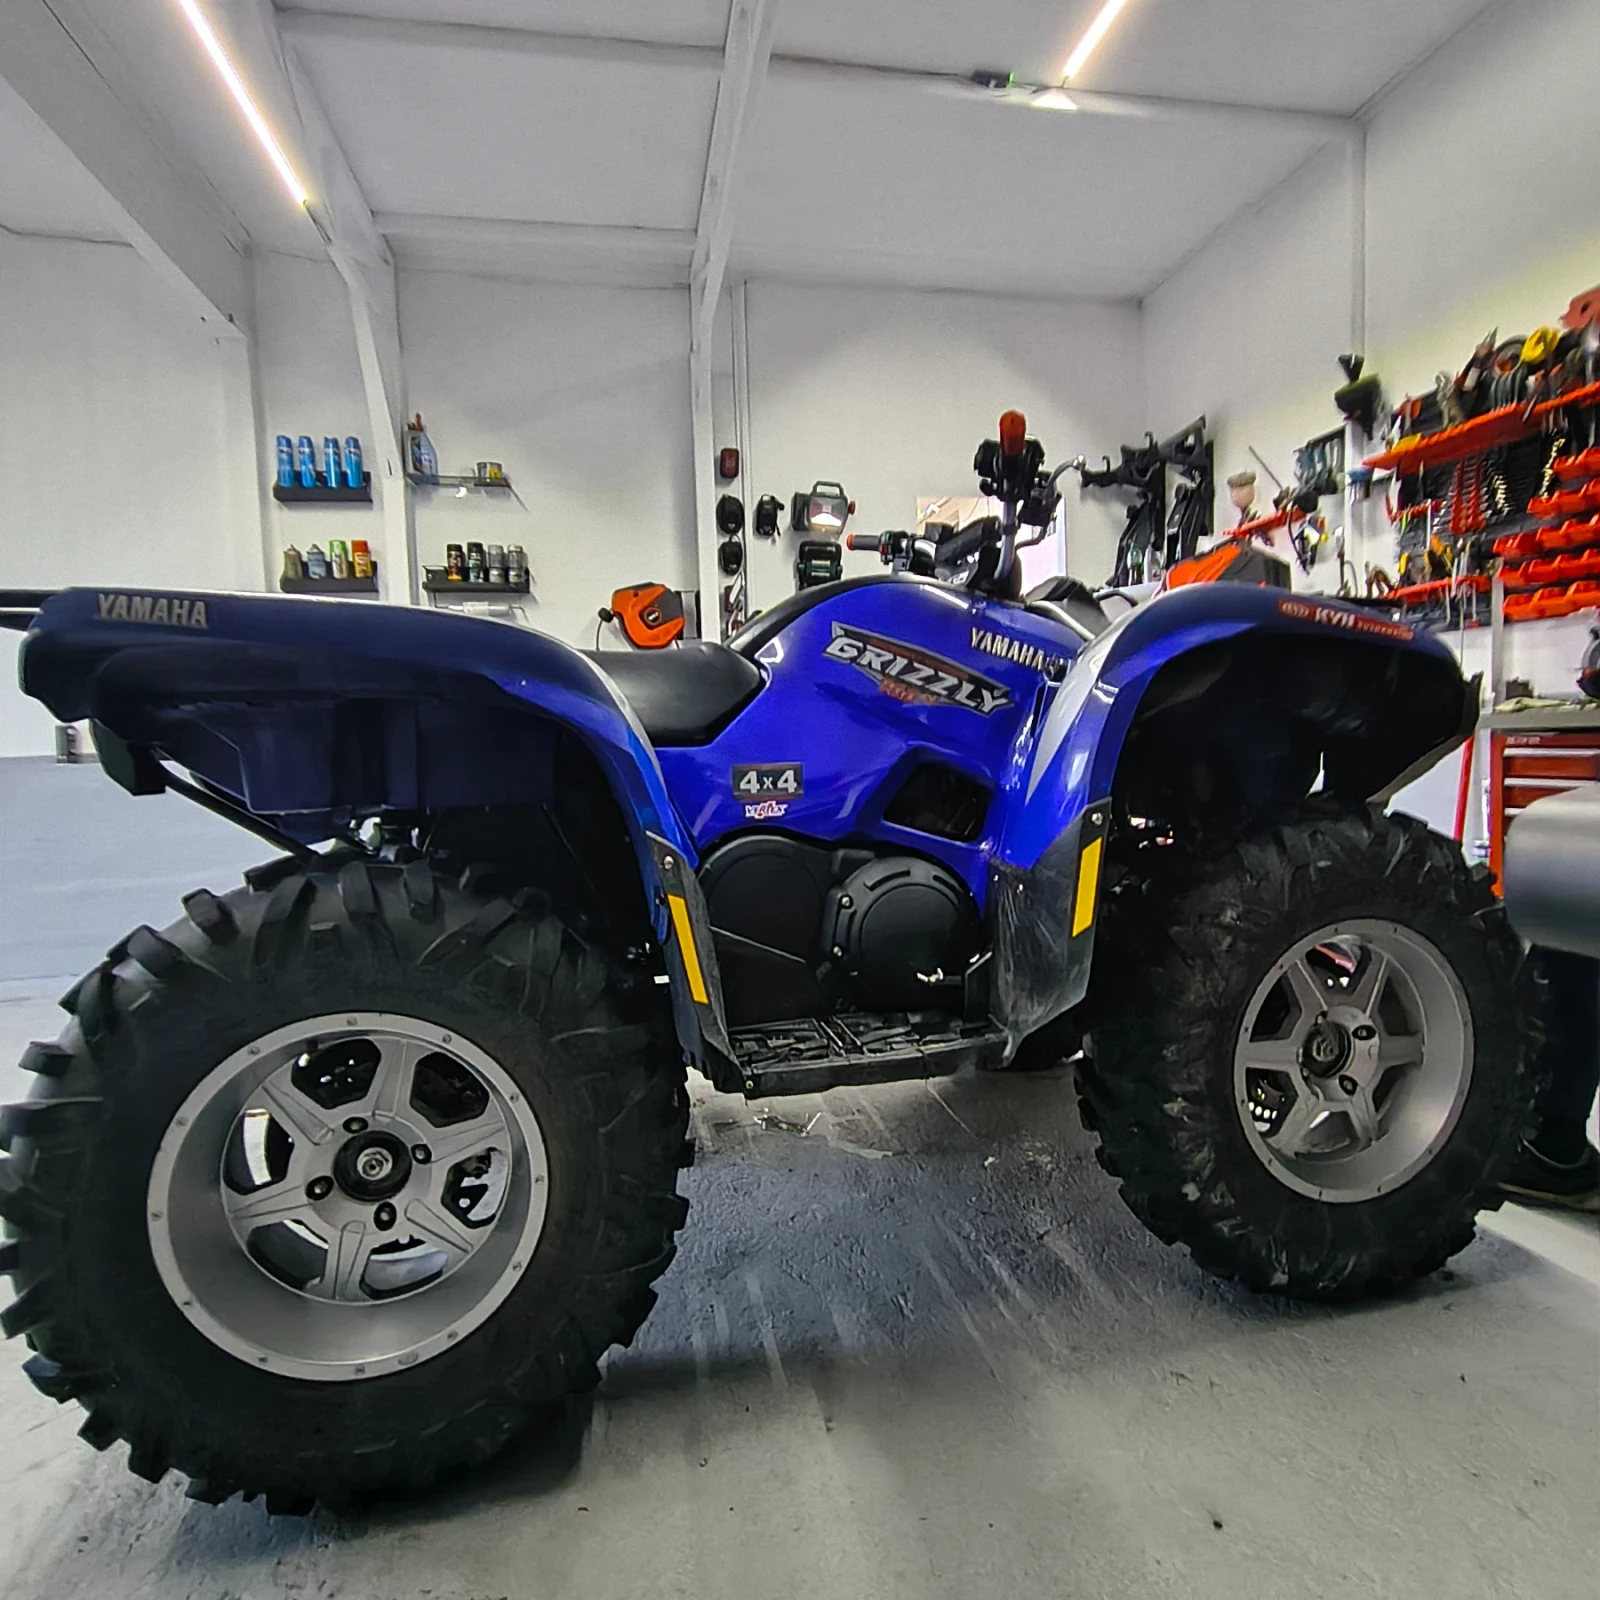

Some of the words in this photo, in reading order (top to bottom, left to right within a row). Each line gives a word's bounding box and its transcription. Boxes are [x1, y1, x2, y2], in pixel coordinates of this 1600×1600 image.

[97, 593, 209, 629] YAMAHA
[970, 627, 1043, 671] YAMAHA
[825, 637, 1009, 713] GRIZZLY
